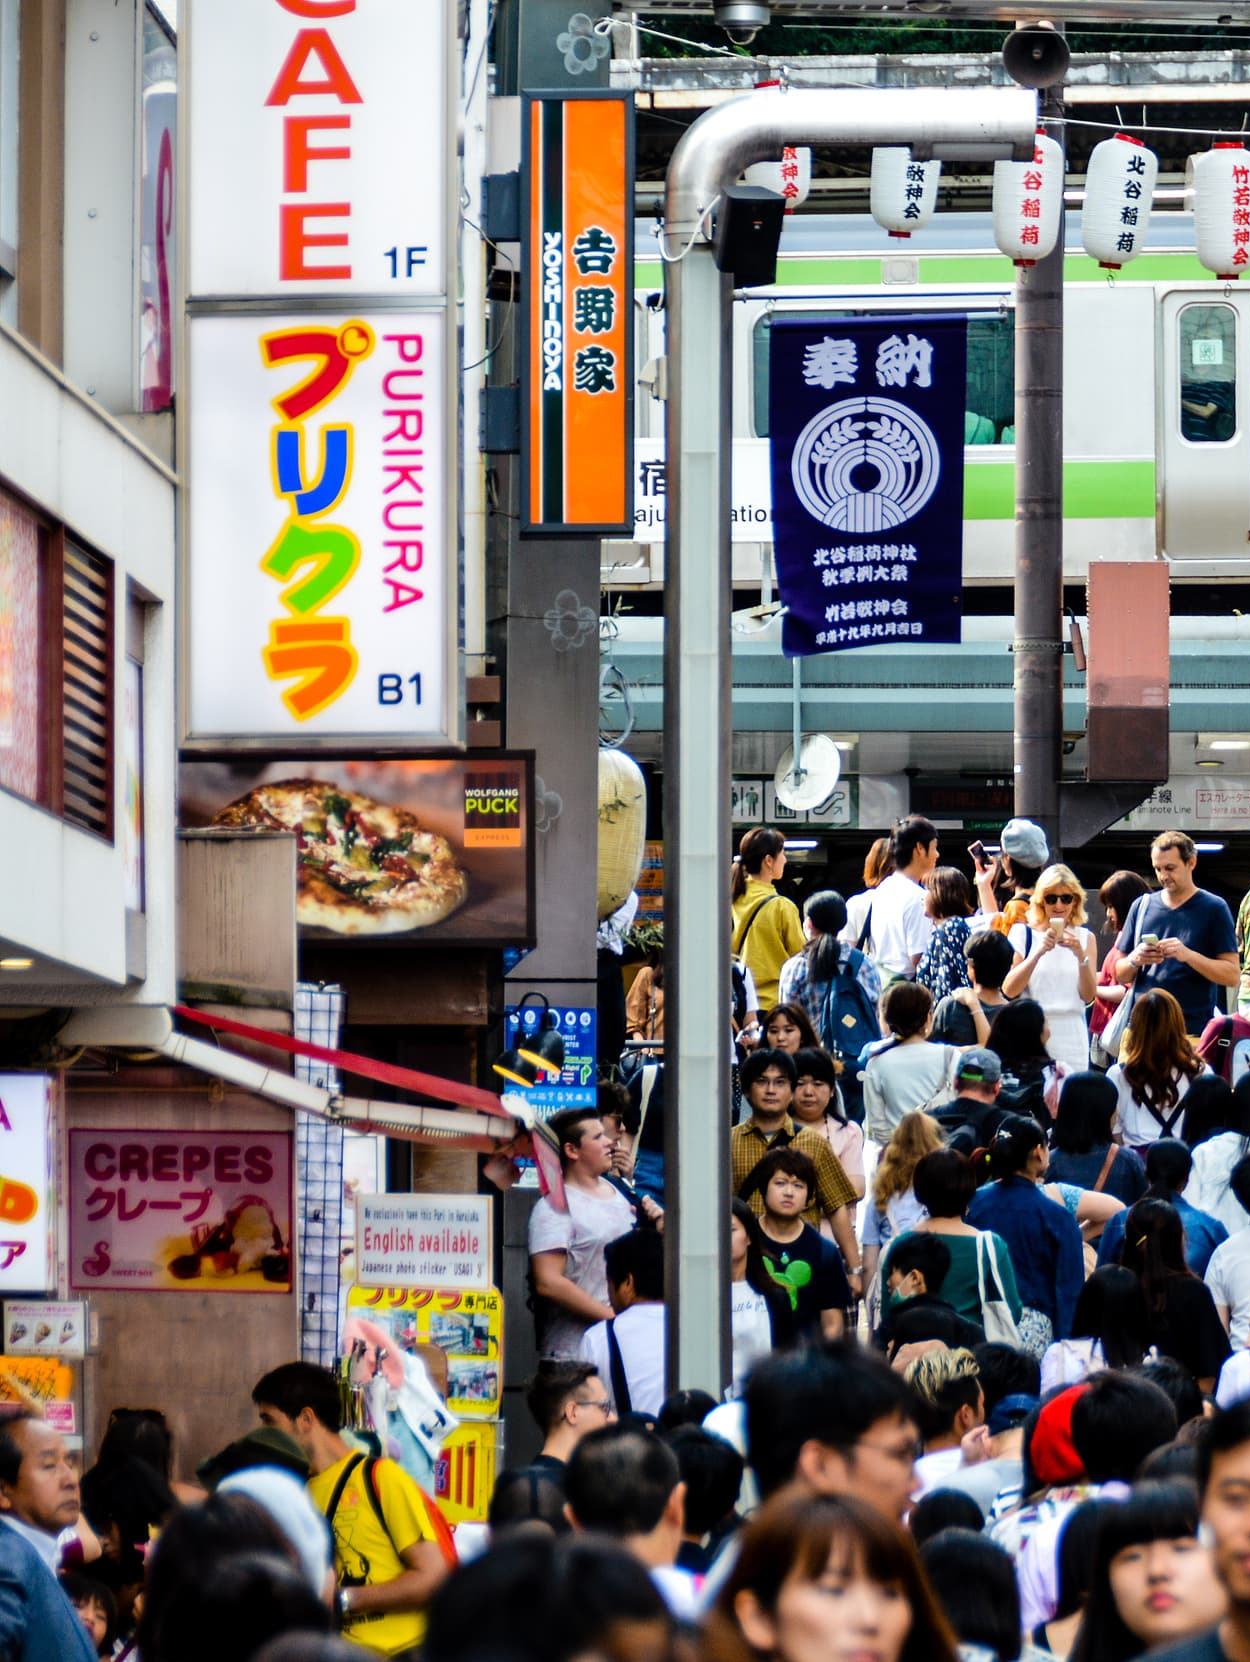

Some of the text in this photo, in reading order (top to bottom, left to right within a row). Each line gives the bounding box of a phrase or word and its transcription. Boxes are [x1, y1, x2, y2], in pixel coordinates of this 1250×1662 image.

[264, 0, 364, 281] AFE
[1116, 154, 1146, 253] 北谷稲荷
[1232, 164, 1250, 266] 竹若敬神会
[383, 247, 428, 279] 1F
[572, 227, 617, 393] 吉野家
[801, 334, 934, 389] 奉納
[382, 333, 424, 614] PURIKURA
[258, 318, 376, 723] プリクラ
[813, 544, 917, 566] 北谷稲荷神社
[821, 564, 909, 587] 秋季例大祭
[824, 598, 909, 622] 竹若敬神会
[378, 674, 424, 706] B1
[465, 789, 519, 797] WOLFGANG
[465, 798, 518, 813] PUCK
[84, 1143, 274, 1184] CREPES
[86, 1187, 213, 1222] クレープ
[364, 1226, 479, 1254] English available
[361, 1260, 392, 1273] Japanese
[396, 1260, 416, 1274] photo
[419, 1262, 447, 1274] sticker
